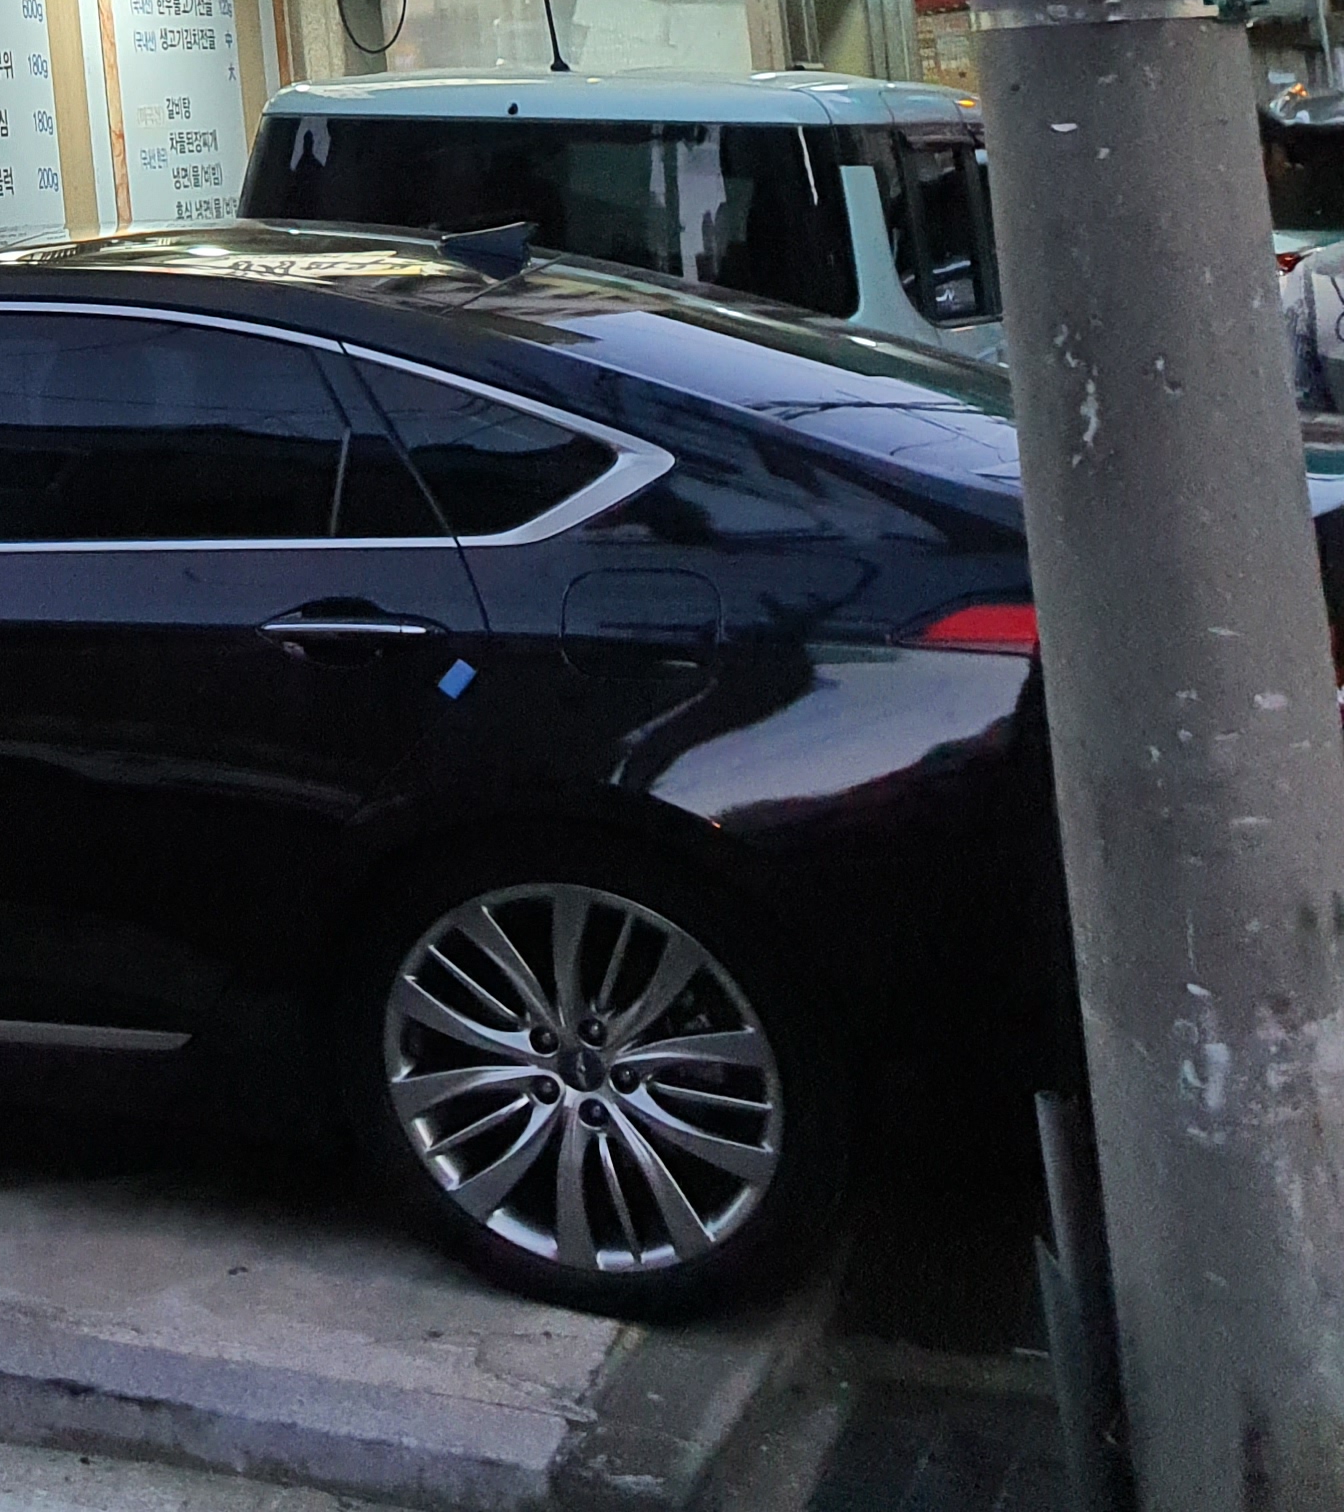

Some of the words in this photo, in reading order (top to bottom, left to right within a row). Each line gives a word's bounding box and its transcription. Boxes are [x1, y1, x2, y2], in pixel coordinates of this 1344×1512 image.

[27, 53, 48, 79] 180g
[165, 96, 191, 120] 갈비탕
[32, 110, 54, 136] 180g
[37, 167, 60, 193] 200g
